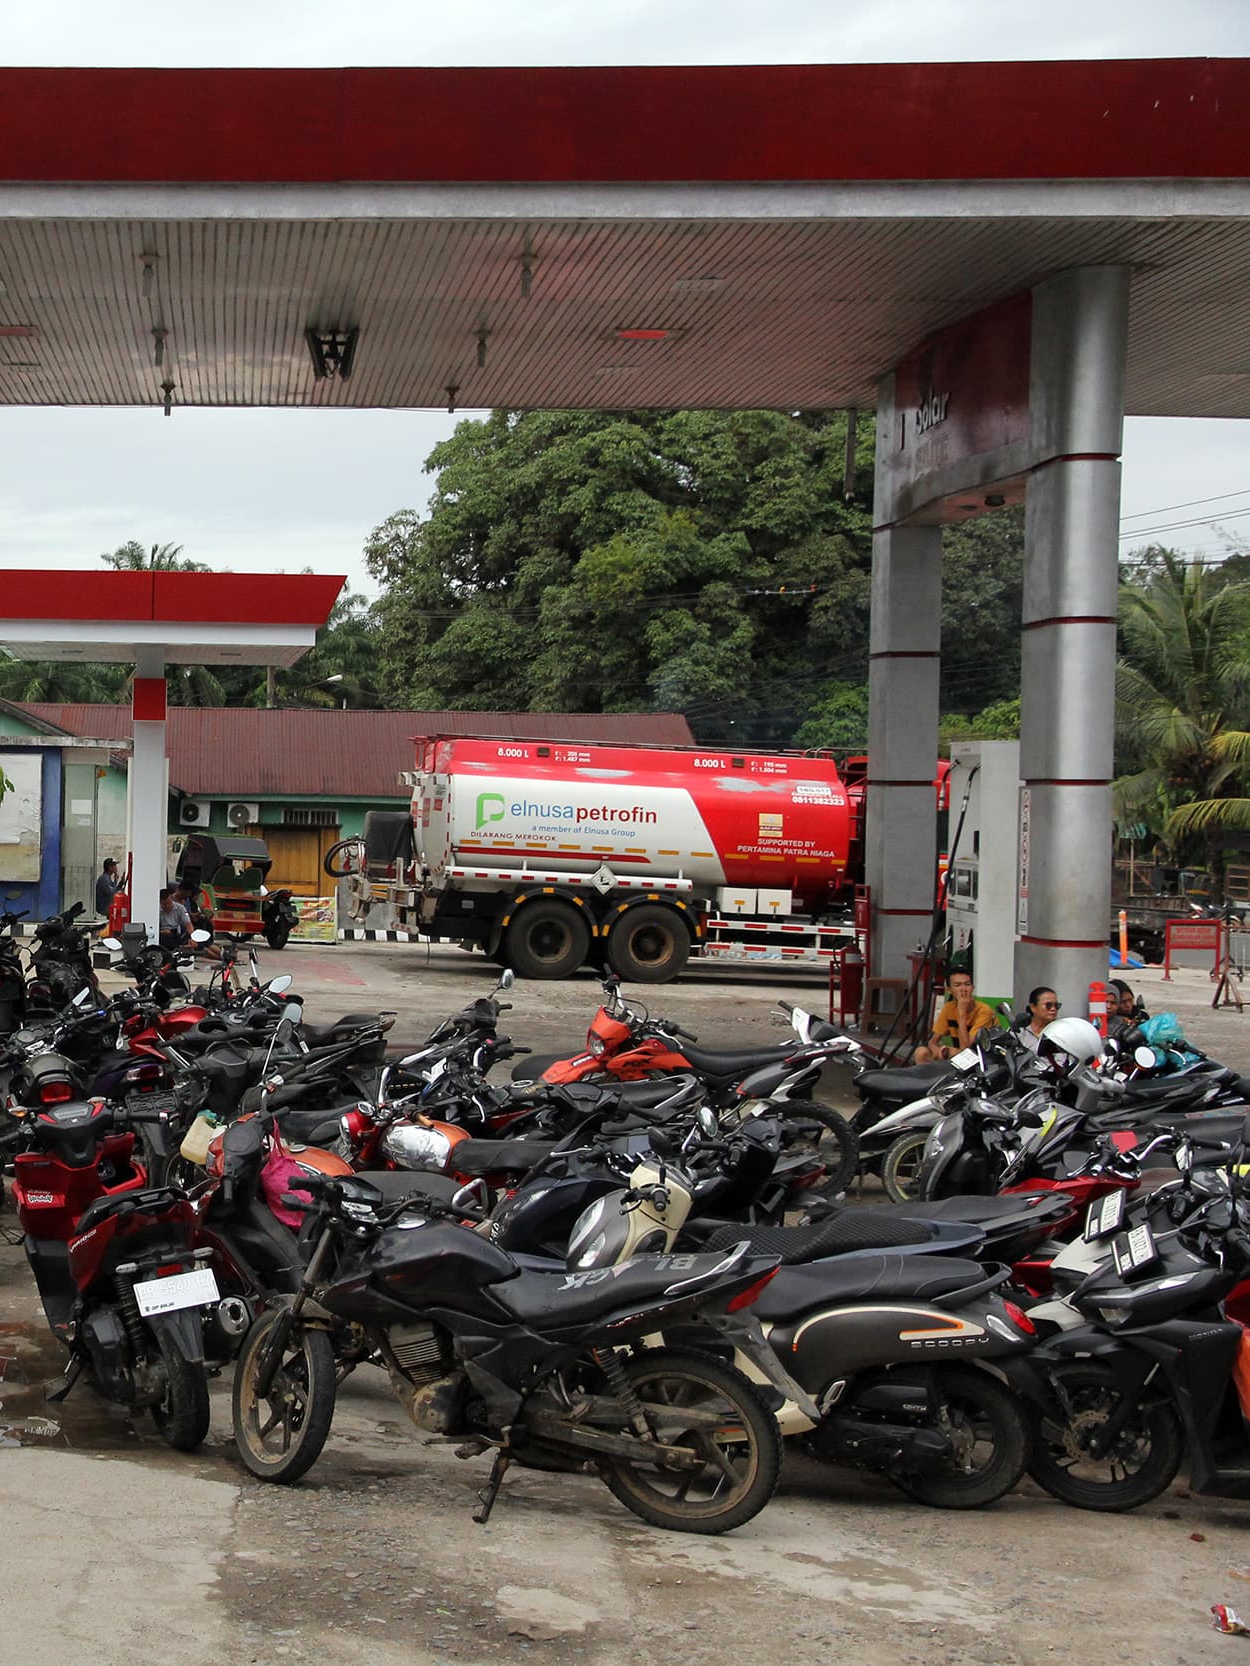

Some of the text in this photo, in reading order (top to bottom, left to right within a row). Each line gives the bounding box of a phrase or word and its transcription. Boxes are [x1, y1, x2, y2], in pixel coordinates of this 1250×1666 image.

[497, 747, 529, 758] 8.000 L
[693, 758, 726, 768] 8.000 L
[511, 800, 657, 823] elnusa petrofin
[470, 831, 557, 842] DILARANG MEROKOK
[538, 825, 570, 833] member
[584, 826, 609, 835] Elnusa
[611, 828, 635, 837] Group
[757, 838, 803, 847] SUPPORTED
[737, 845, 835, 858] PERTAMINA PATRA NIAGA
[910, 1337, 990, 1349] SCOOPY
